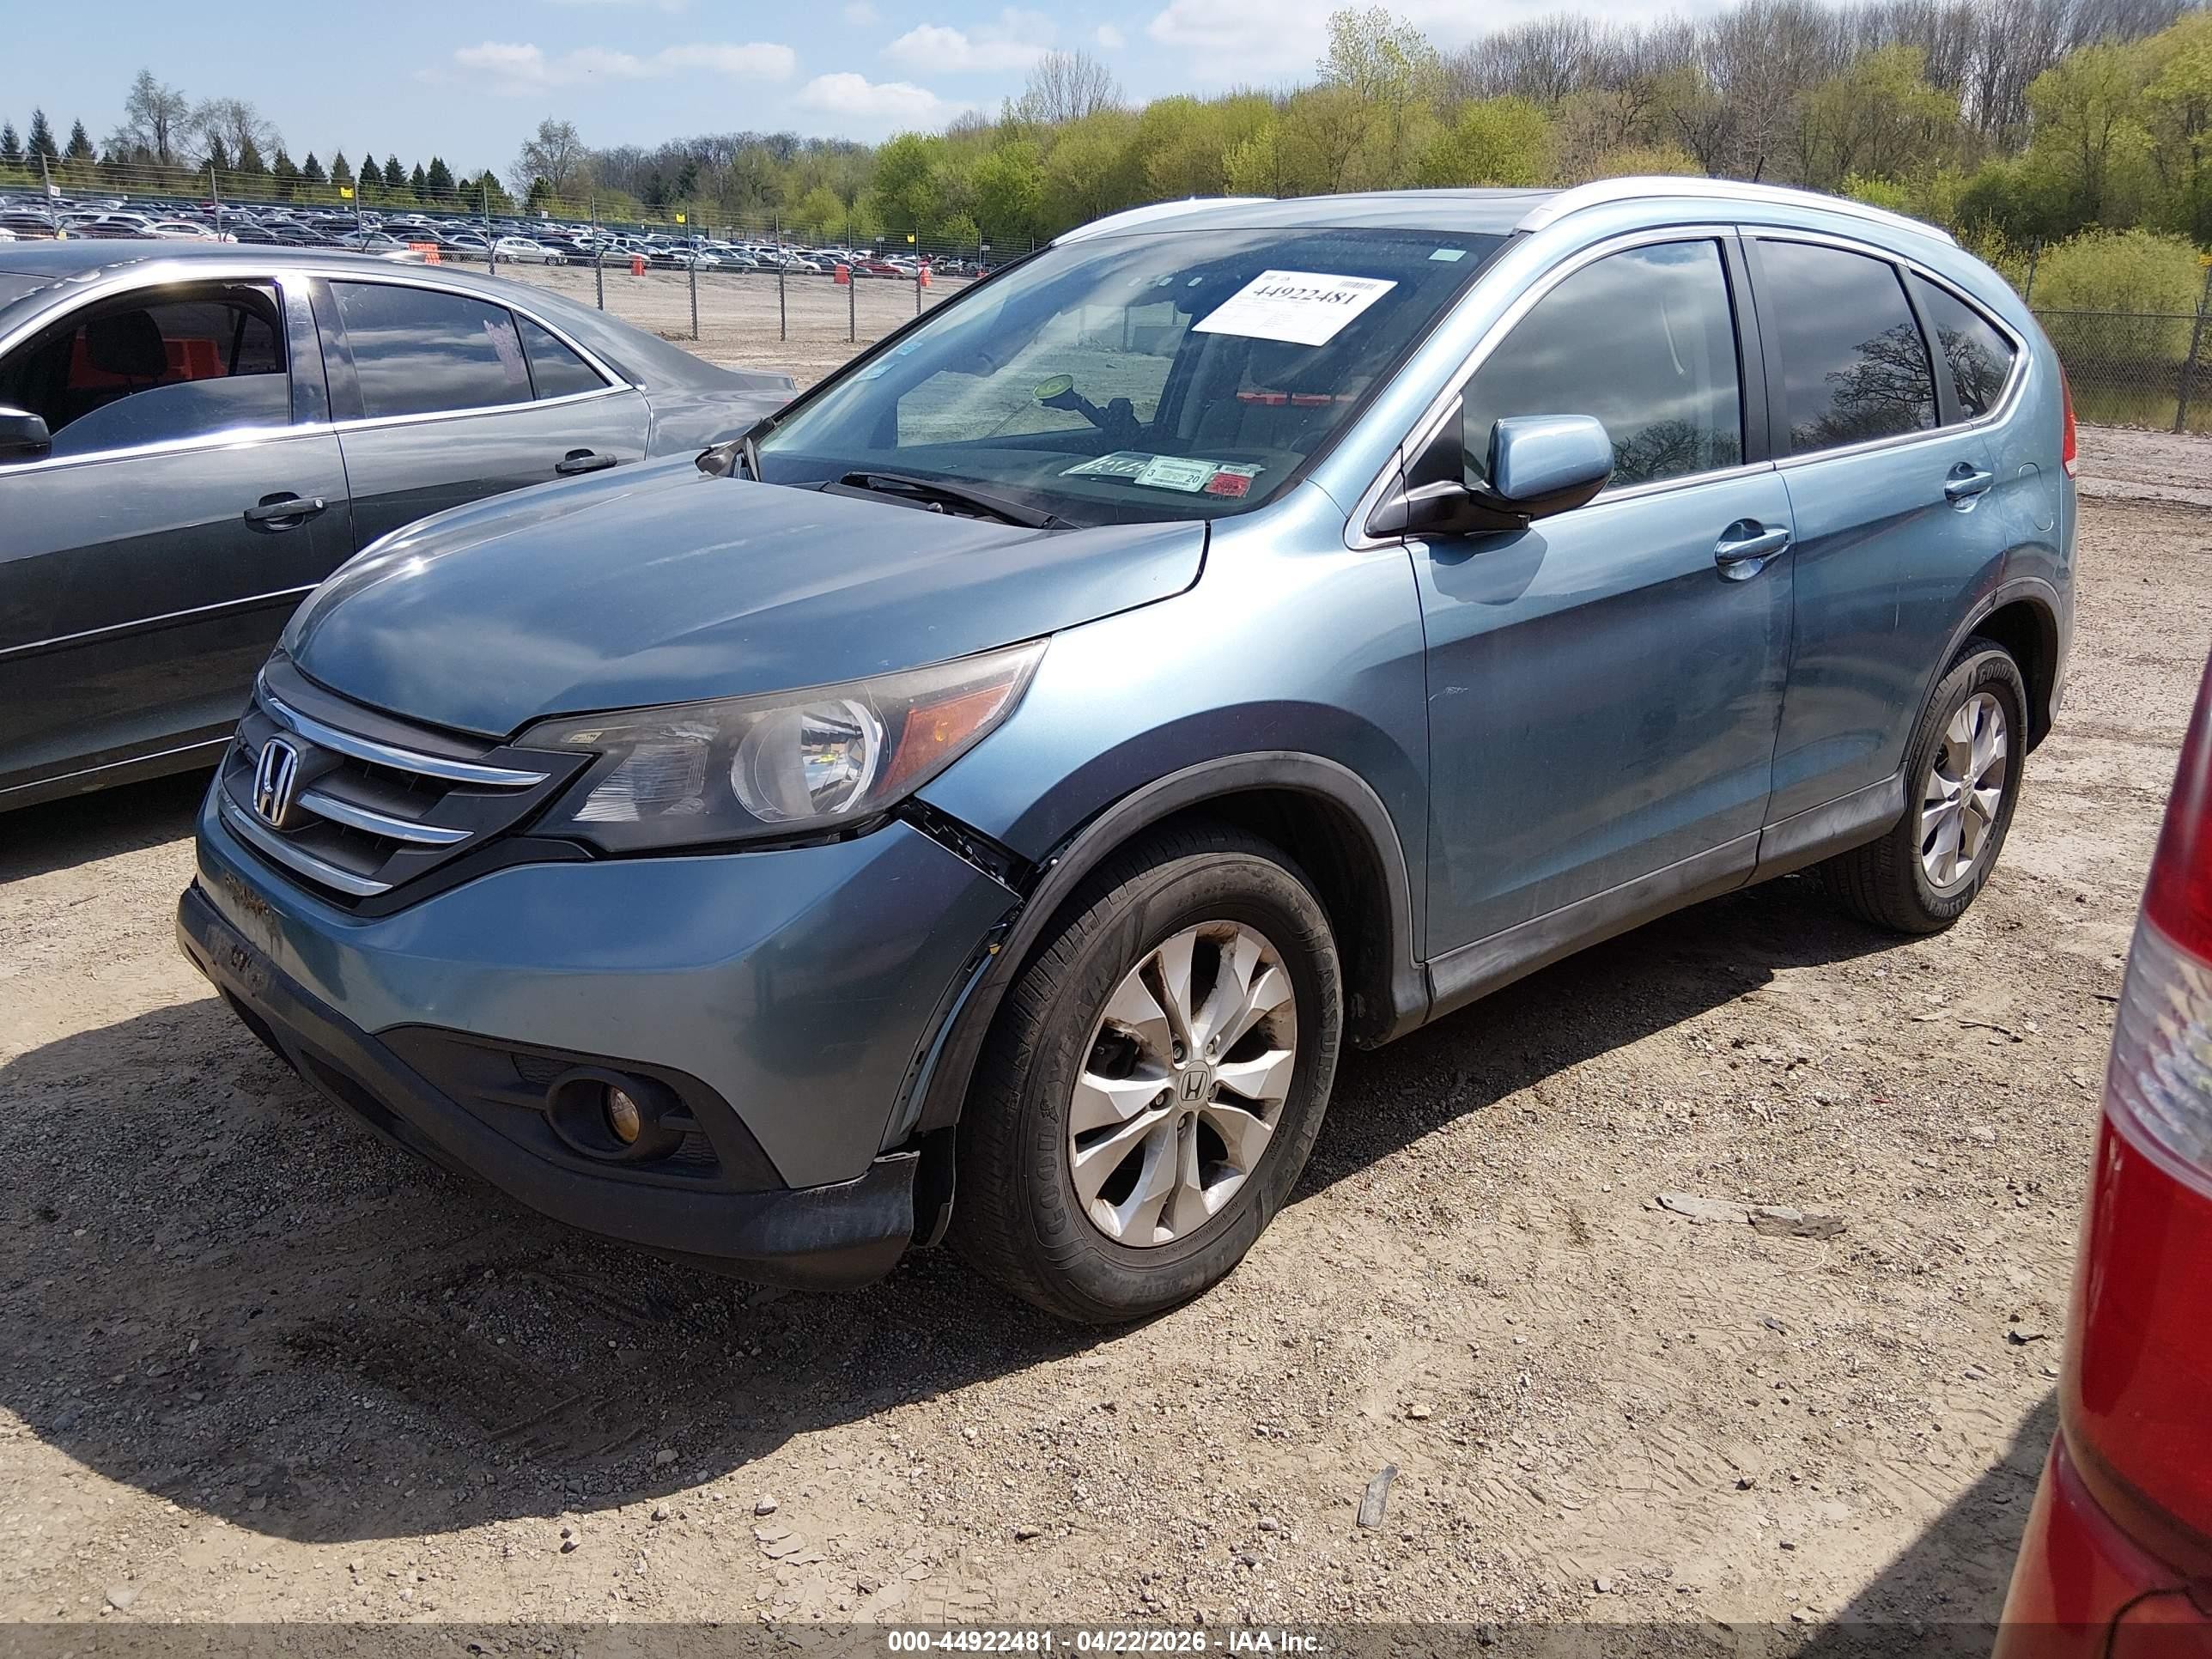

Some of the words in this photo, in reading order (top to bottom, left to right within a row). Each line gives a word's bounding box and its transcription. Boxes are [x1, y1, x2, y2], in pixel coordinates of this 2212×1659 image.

[1254, 285, 1358, 305] 44922481
[1147, 469, 1156, 477] 3
[1186, 474, 1200, 483] 20
